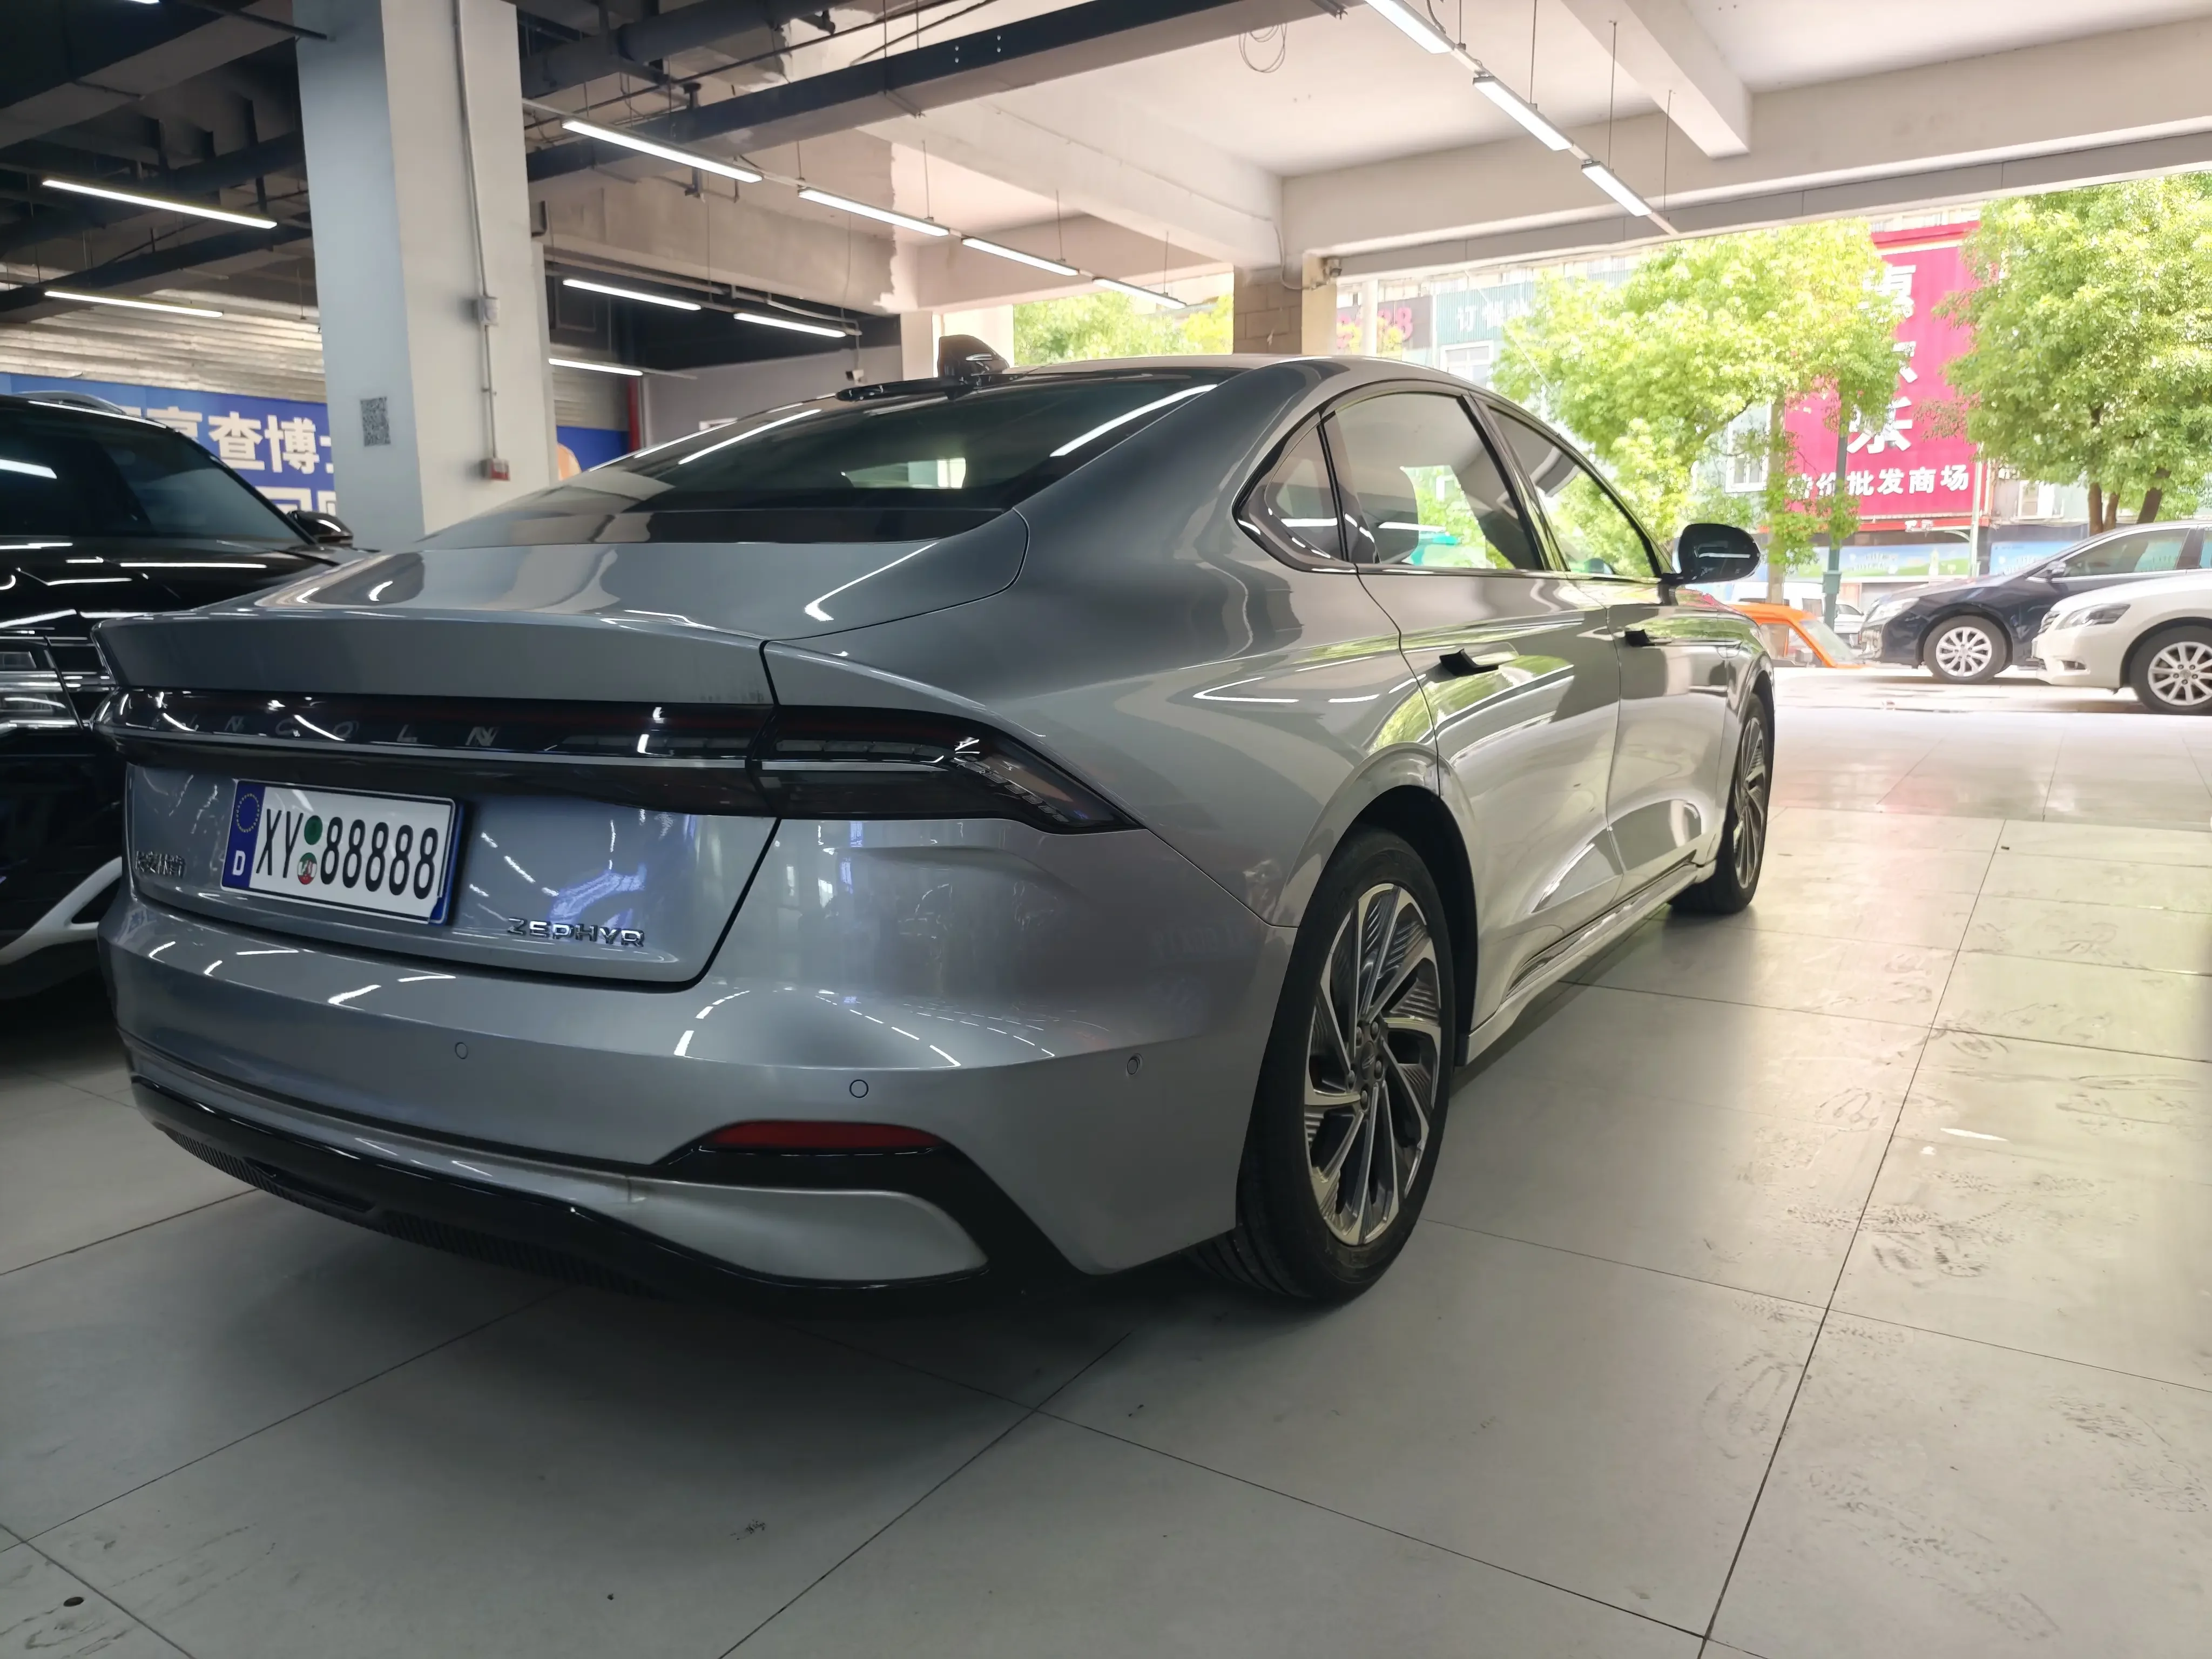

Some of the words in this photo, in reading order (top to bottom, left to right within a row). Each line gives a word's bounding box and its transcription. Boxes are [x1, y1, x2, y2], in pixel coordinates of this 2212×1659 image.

[232, 851, 245, 875] D
[256, 808, 304, 878] XY
[320, 817, 439, 899] 88888
[507, 918, 644, 947] ZEPHYR
